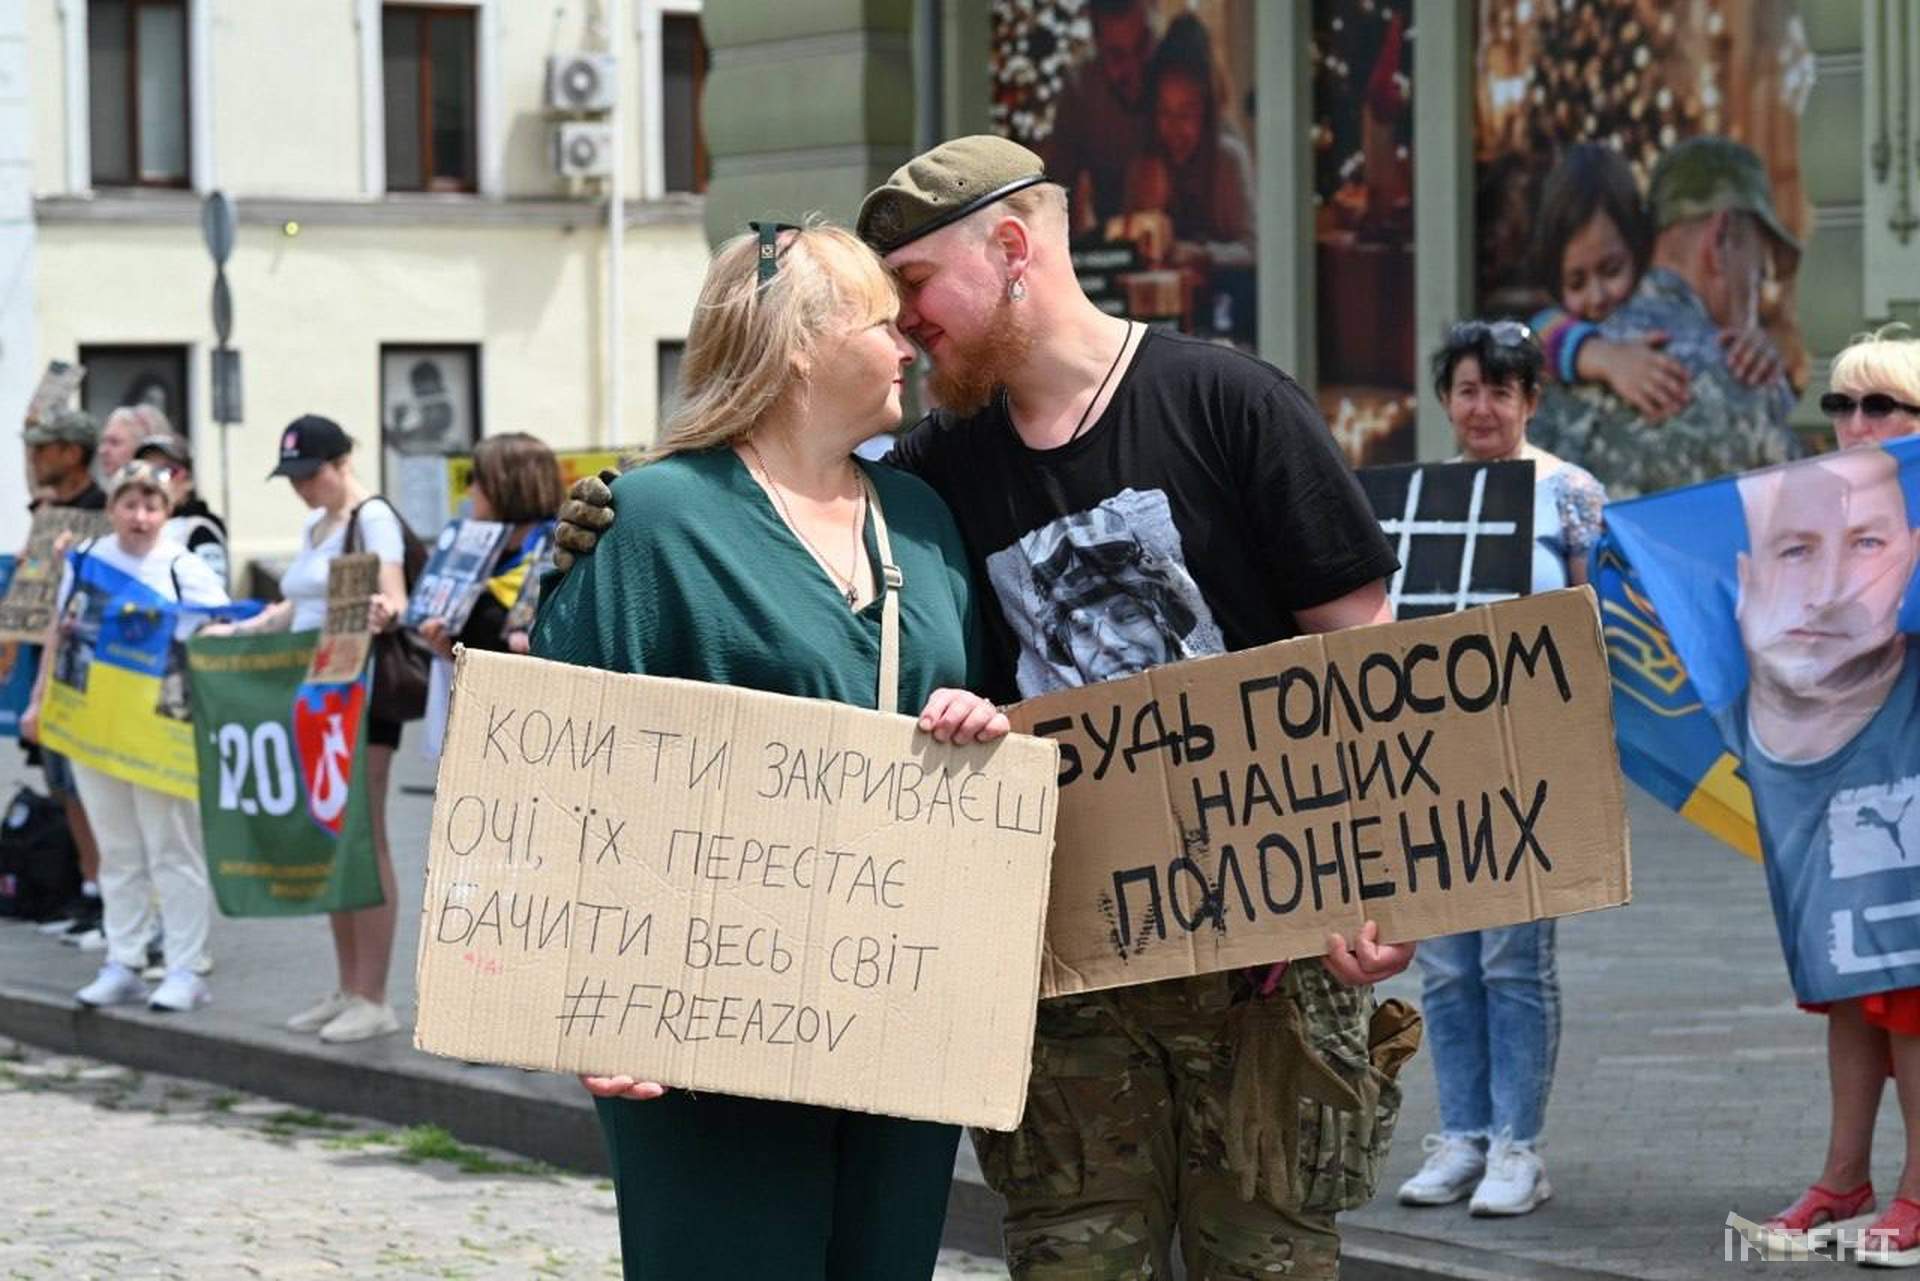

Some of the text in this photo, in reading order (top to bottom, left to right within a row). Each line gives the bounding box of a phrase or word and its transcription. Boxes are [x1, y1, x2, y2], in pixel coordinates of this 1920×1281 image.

[1033, 625, 1572, 786] БУДЬ ГОЛОСОМ
[482, 705, 1047, 835] КОЛИ ТИ ЗАКРИВАЄШ
[1193, 730, 1440, 843] НАШИХ
[573, 804, 627, 865] ЇХ
[666, 829, 905, 908] ПЕРЕСТАЄ
[1112, 779, 1552, 947] ПОЛОНЕНИХ
[437, 883, 651, 957] БАЧИТИ
[686, 916, 793, 973] ВЕСЬ
[557, 976, 857, 1052] #FREEAZOV
